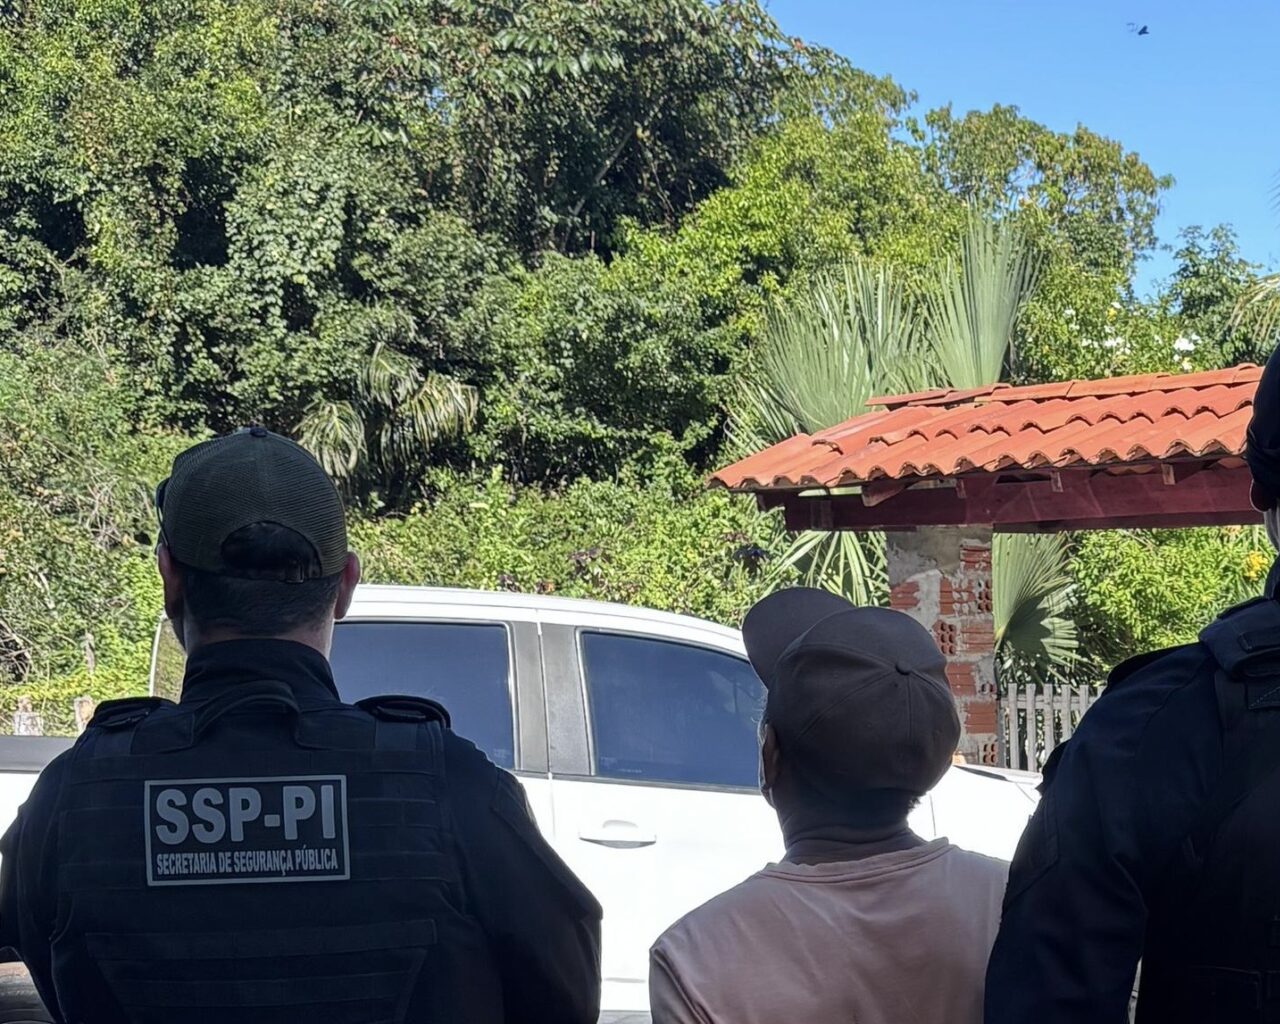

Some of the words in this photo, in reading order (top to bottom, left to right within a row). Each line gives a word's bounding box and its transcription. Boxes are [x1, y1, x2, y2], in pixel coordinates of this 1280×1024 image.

[155, 784, 337, 845] SSP-PI
[156, 852, 217, 875] SECRETARIA
[218, 851, 232, 873] DE
[233, 849, 294, 876] SEGURANÇA
[295, 844, 339, 870] PÚBLICA
